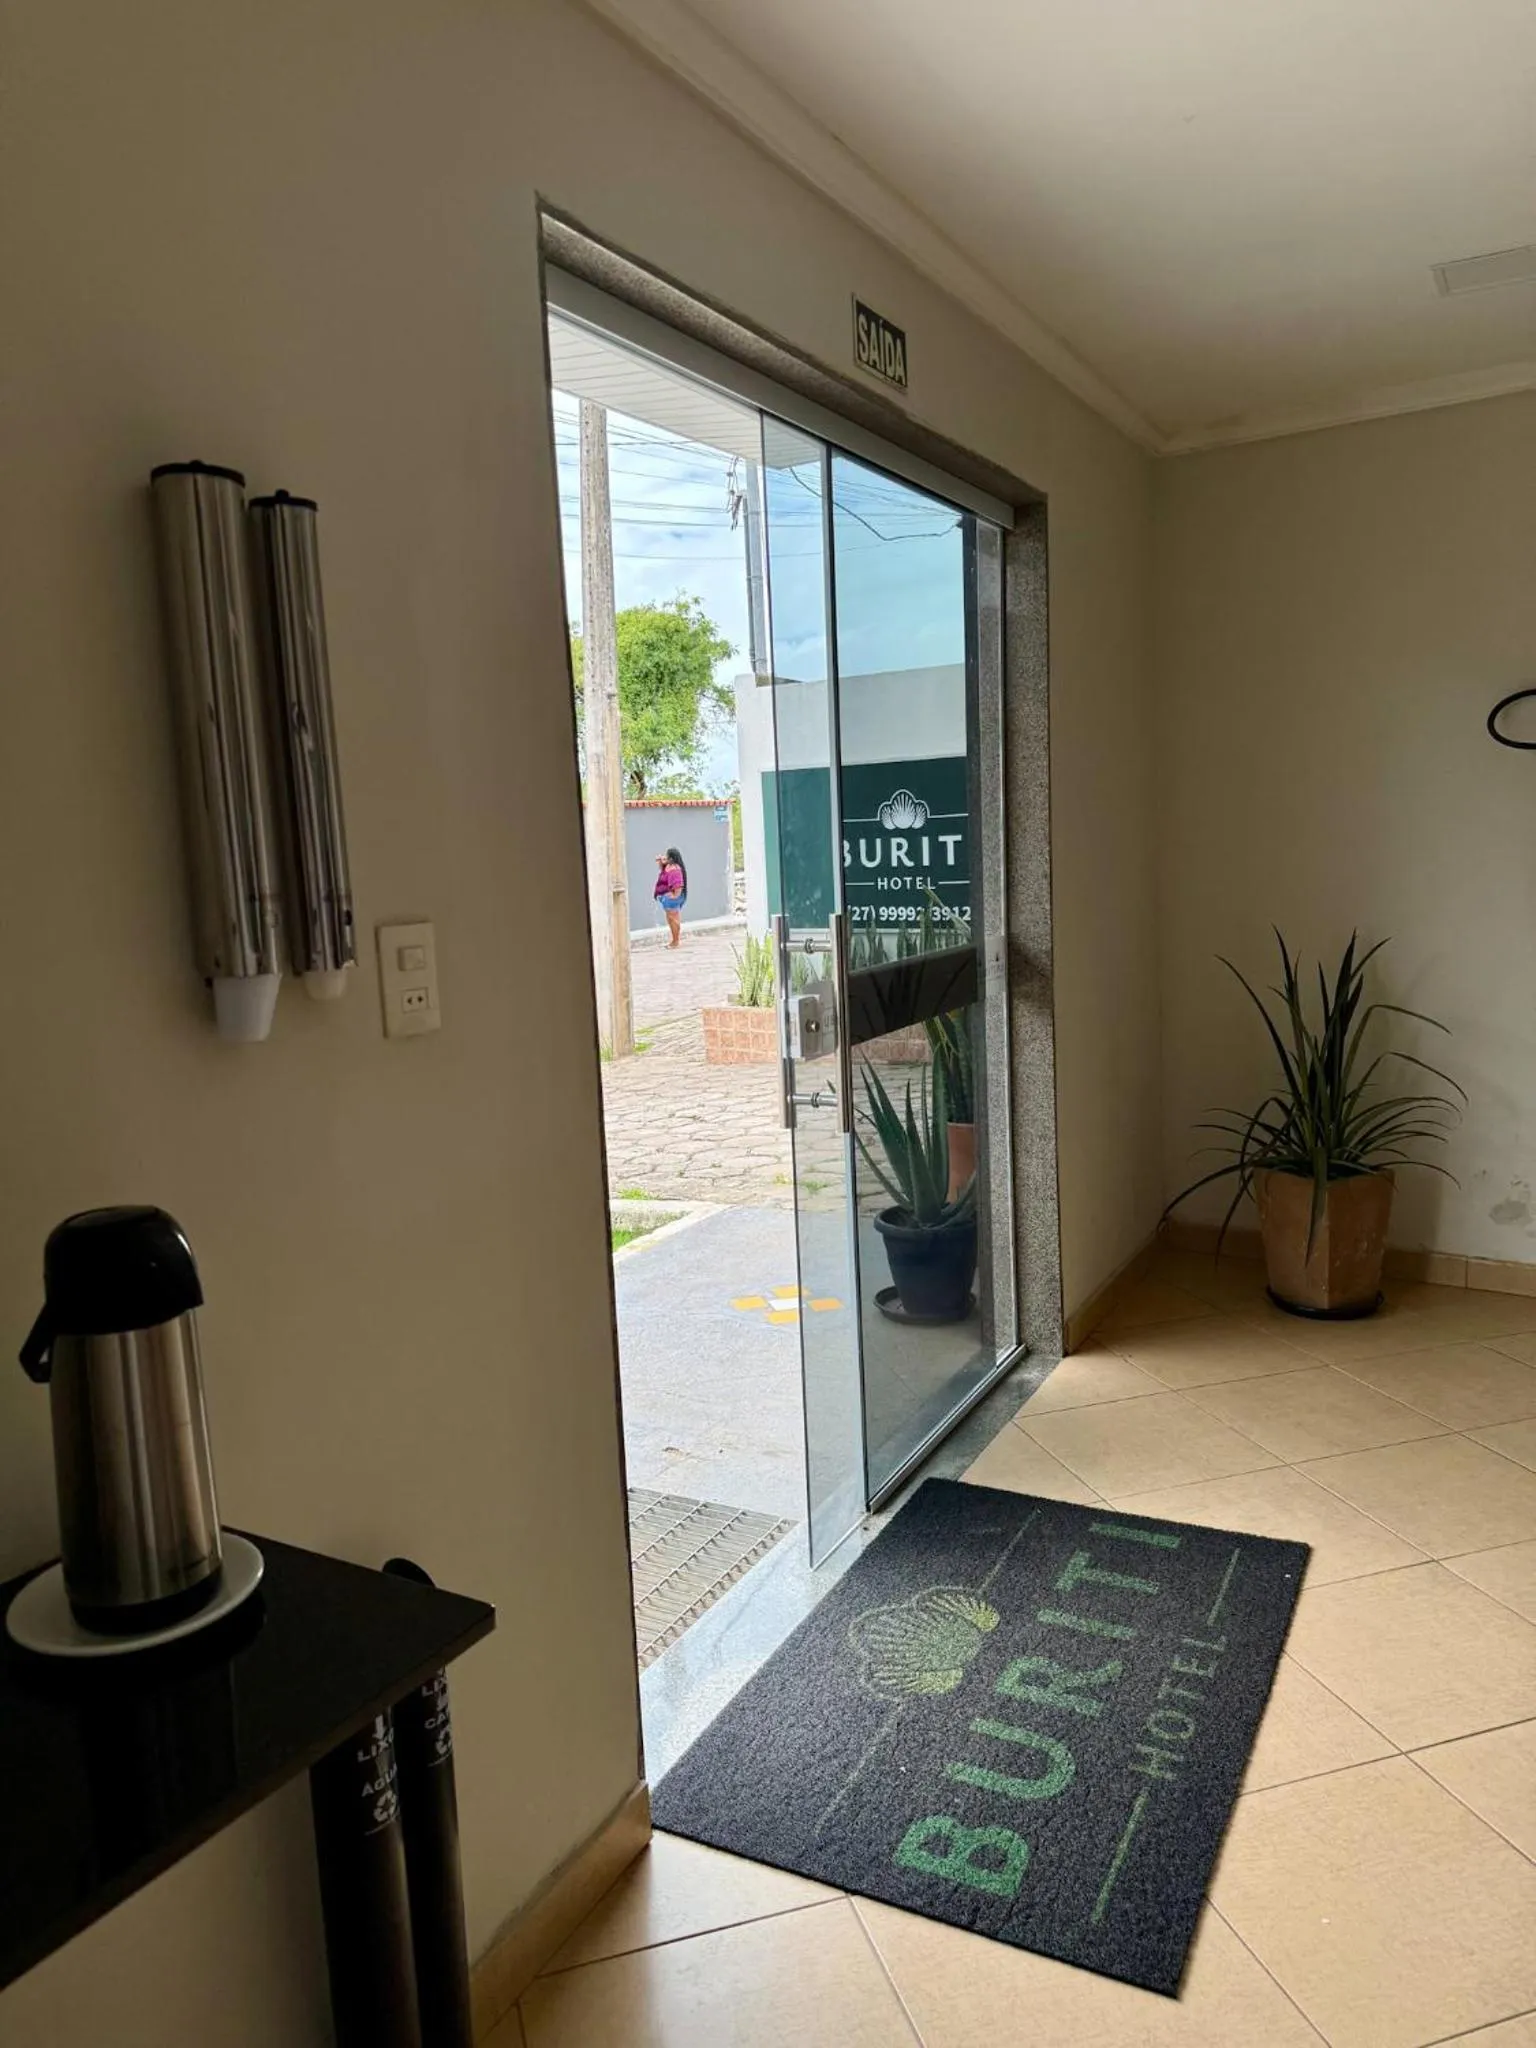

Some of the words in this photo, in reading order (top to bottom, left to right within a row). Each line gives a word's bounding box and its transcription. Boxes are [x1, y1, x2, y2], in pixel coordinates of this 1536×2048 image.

[858, 312, 906, 386] SAÍDA
[877, 876, 936, 891] HOTEL
[893, 1521, 1183, 1898] BURITI
[1129, 1632, 1229, 1781] HOTEL
